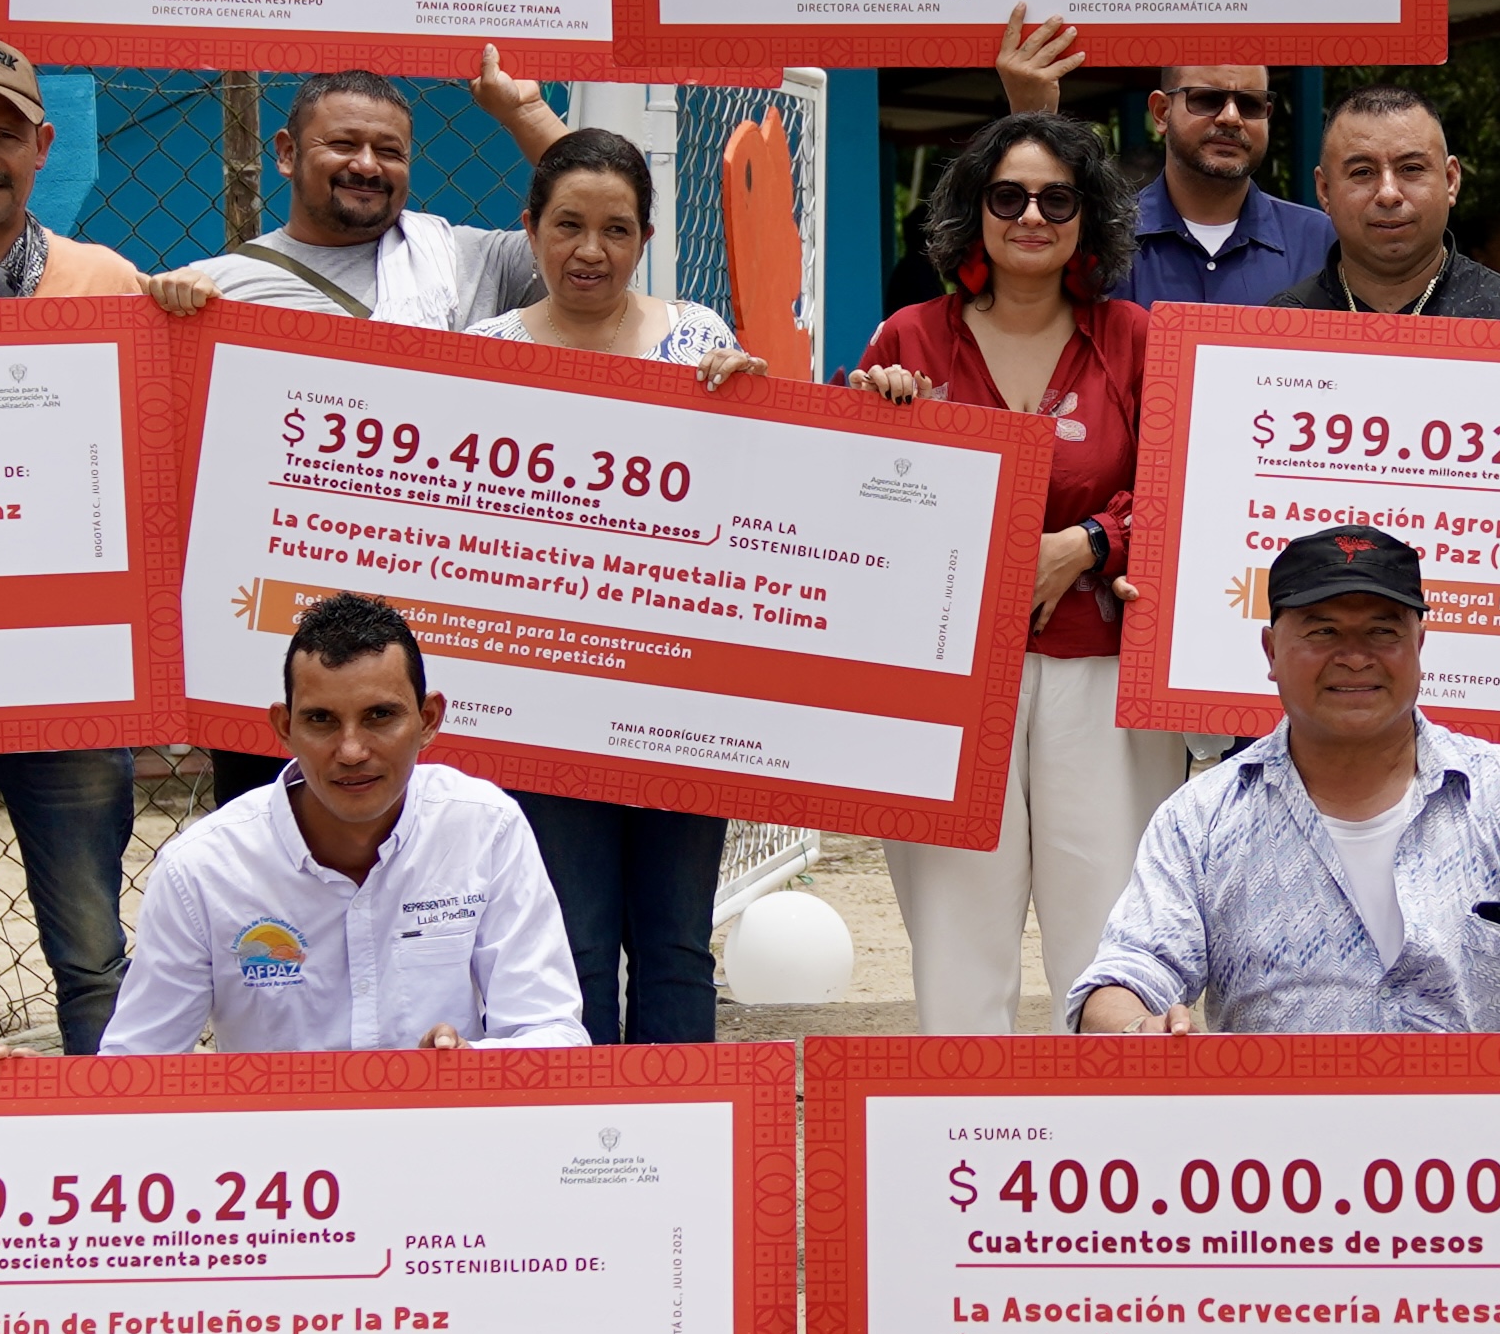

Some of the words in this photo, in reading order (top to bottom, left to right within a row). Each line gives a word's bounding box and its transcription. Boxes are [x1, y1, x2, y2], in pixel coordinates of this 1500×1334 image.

[797, 2, 860, 12] DIRECTORA
[863, 2, 914, 12] GENERAL
[917, 2, 940, 12] ARN
[610, 721, 645, 734] TANIA
[648, 726, 716, 744] RODRÍGUEZ
[719, 736, 762, 750] TRIANA
[608, 736, 671, 753] DIRECTORA
[674, 745, 763, 765] PROGRAMÁTICA
[766, 757, 790, 769] ARN
[463, 893, 487, 905] LEGAL
[245, 962, 299, 980] AFPAZ
[571, 1156, 610, 1167] Agencia
[612, 1157, 634, 1165] para
[636, 1155, 645, 1164] la
[561, 1165, 639, 1175] Reincorporación
[641, 1167, 647, 1175] y
[649, 1165, 658, 1173] la
[559, 1174, 627, 1185] Normalización
[636, 1174, 659, 1183] ARN
[953, 1296, 989, 1322] La
[1002, 1294, 1185, 1323] Asociación
[1197, 1295, 1380, 1323] Cervecería
